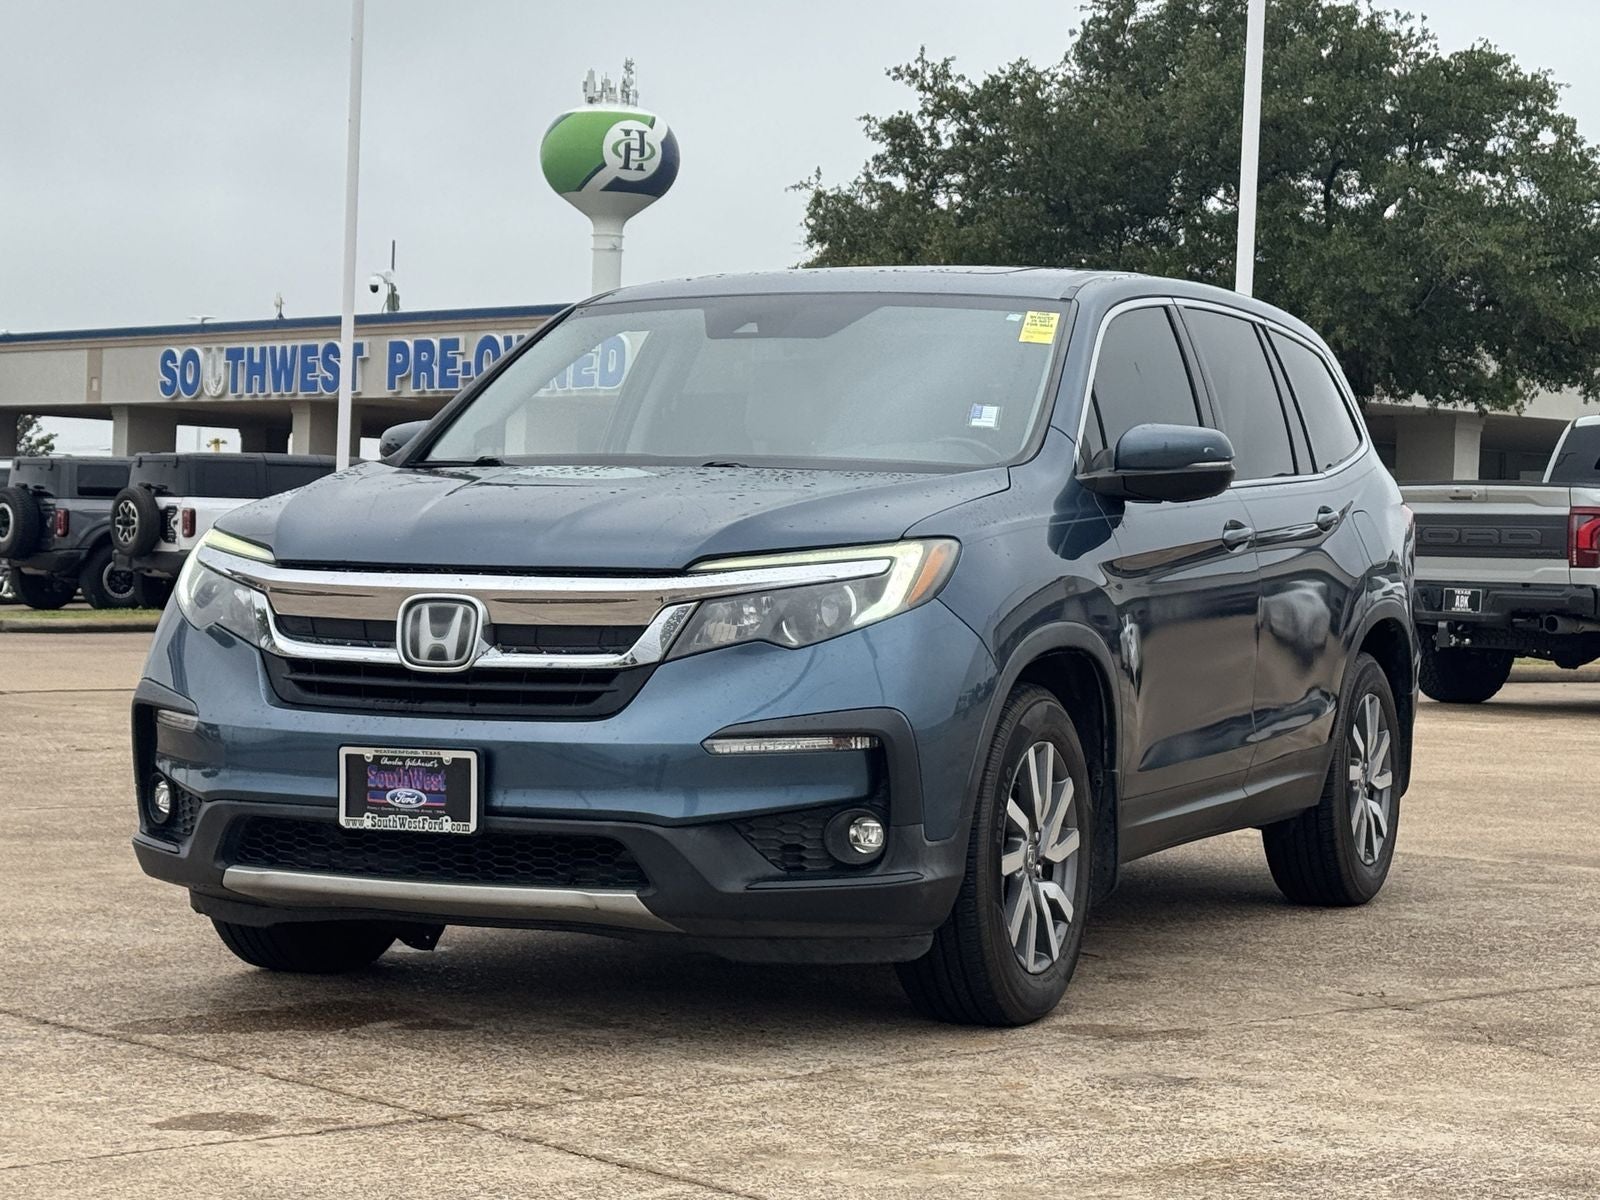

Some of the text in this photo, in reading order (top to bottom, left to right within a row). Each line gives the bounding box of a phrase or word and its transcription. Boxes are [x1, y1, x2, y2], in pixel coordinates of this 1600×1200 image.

[159, 334, 632, 398] SOUTHWEST PRE-OED
[1416, 527, 1542, 545] ORD
[367, 765, 447, 791] SouthWest
[394, 791, 418, 804] Ford
[344, 815, 470, 833] www.SouthWestFord.com
